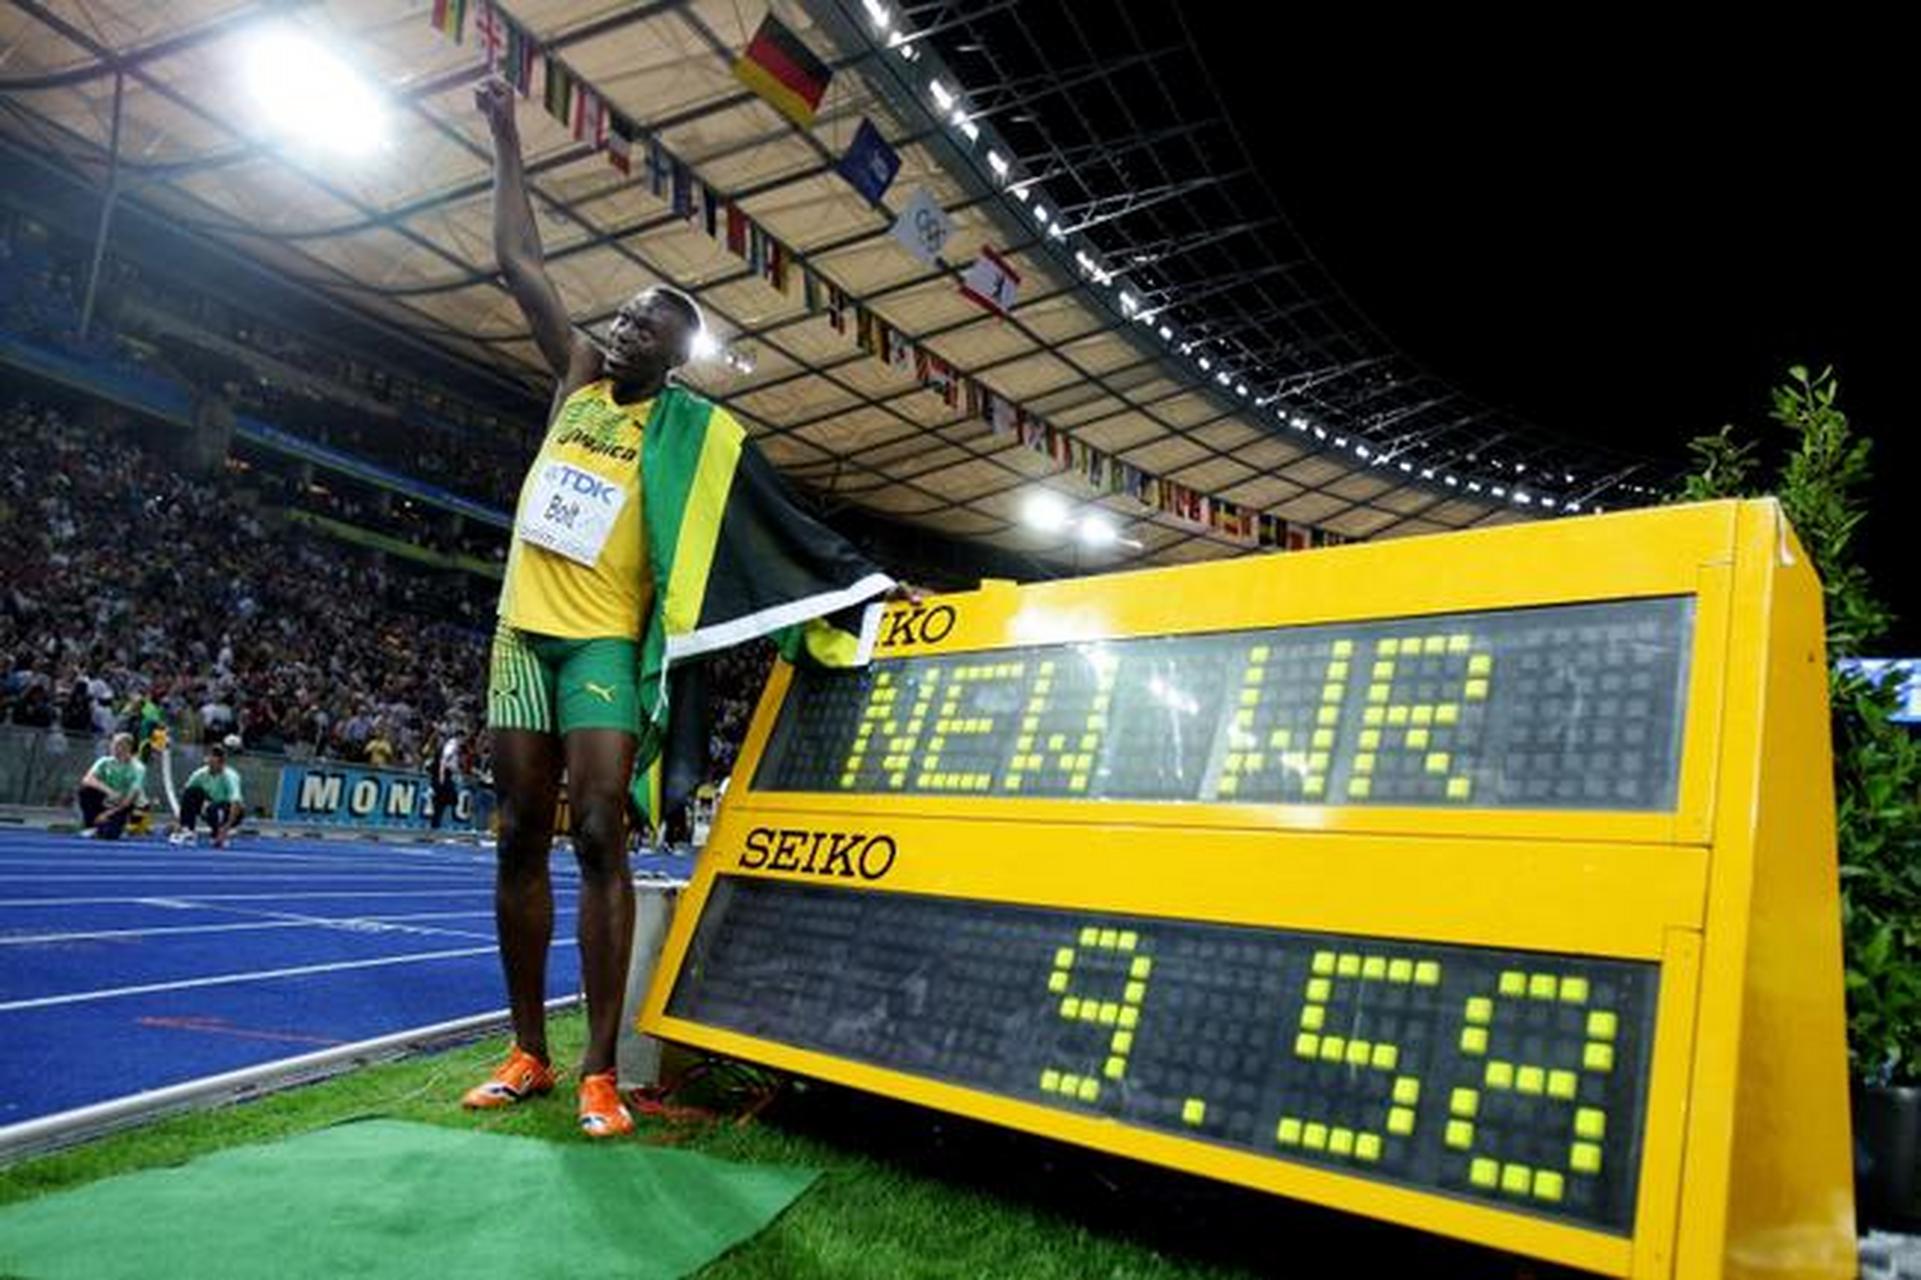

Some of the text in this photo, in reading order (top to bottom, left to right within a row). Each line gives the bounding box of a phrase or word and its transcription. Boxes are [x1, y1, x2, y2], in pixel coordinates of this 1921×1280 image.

[561, 466, 616, 504] TDK
[840, 634, 1492, 799] NEW WR
[739, 828, 896, 879] SEIKO
[1040, 926, 1618, 1200] 9.58
